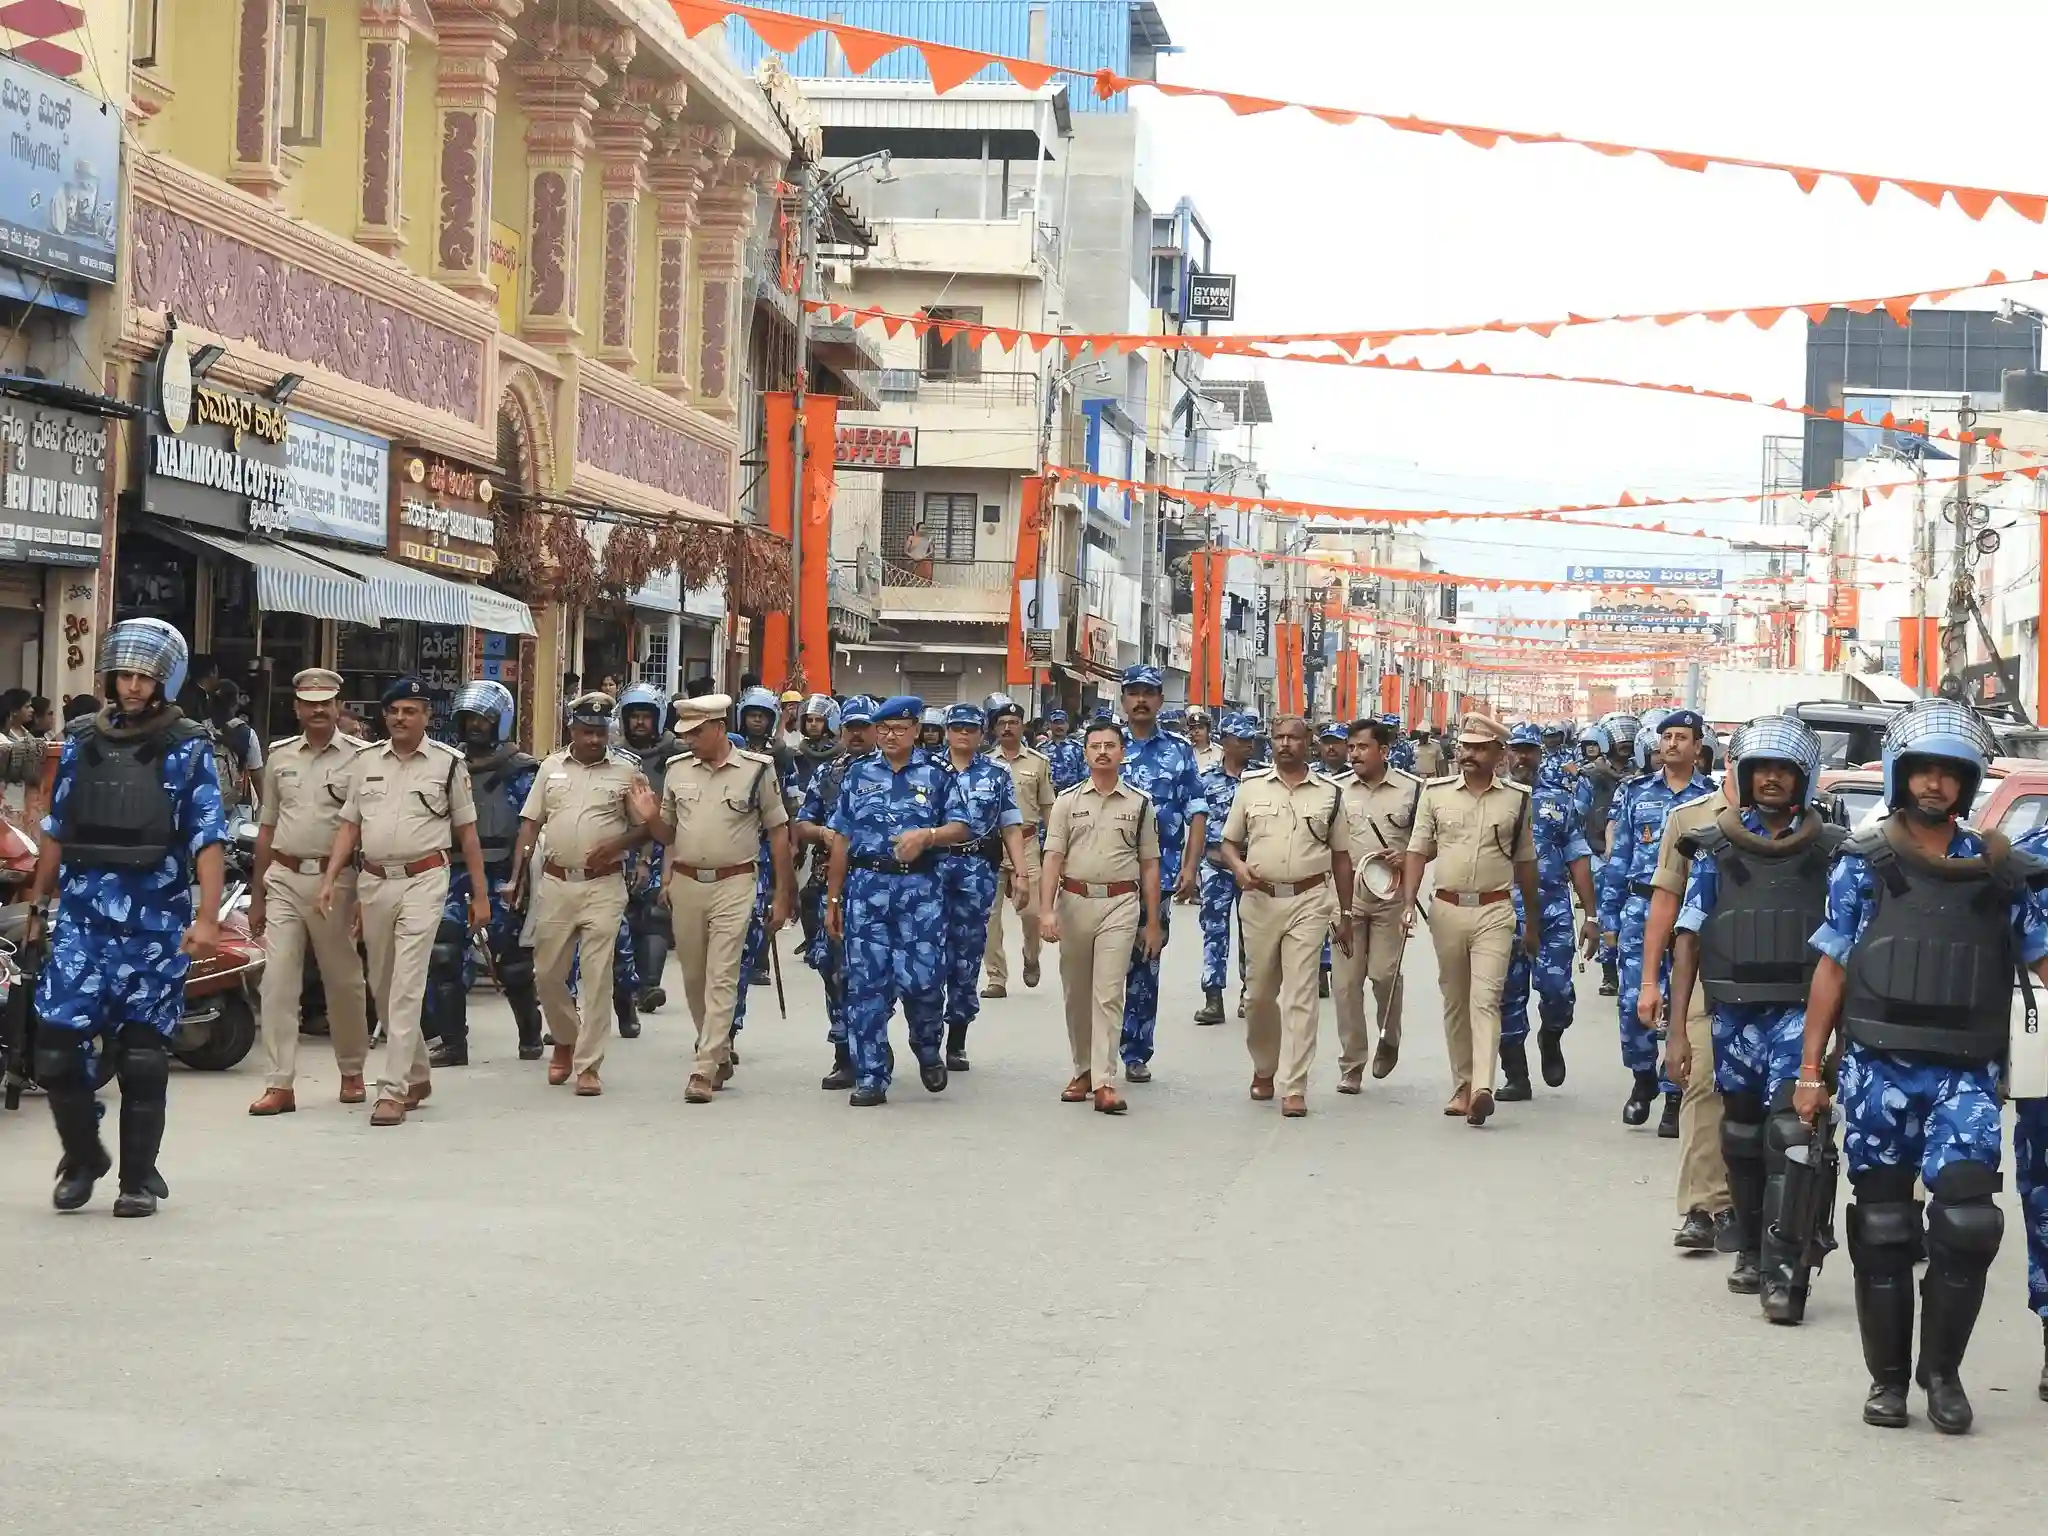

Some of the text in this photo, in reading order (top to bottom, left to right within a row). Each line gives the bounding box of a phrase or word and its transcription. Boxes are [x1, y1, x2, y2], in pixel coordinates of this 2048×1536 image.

[1193, 286, 1230, 297] GYMM
[1193, 296, 1229, 306] BOXX
[836, 428, 912, 448] NESHA
[154, 434, 294, 504] NAMMOORA COFFEE
[836, 443, 901, 465] OFFEE
[31, 476, 58, 515] DEVI
[58, 480, 99, 521] STORES
[338, 494, 381, 527] TRADERS
[1256, 586, 1268, 616] BODY
[1311, 591, 1323, 651] VASAVI
